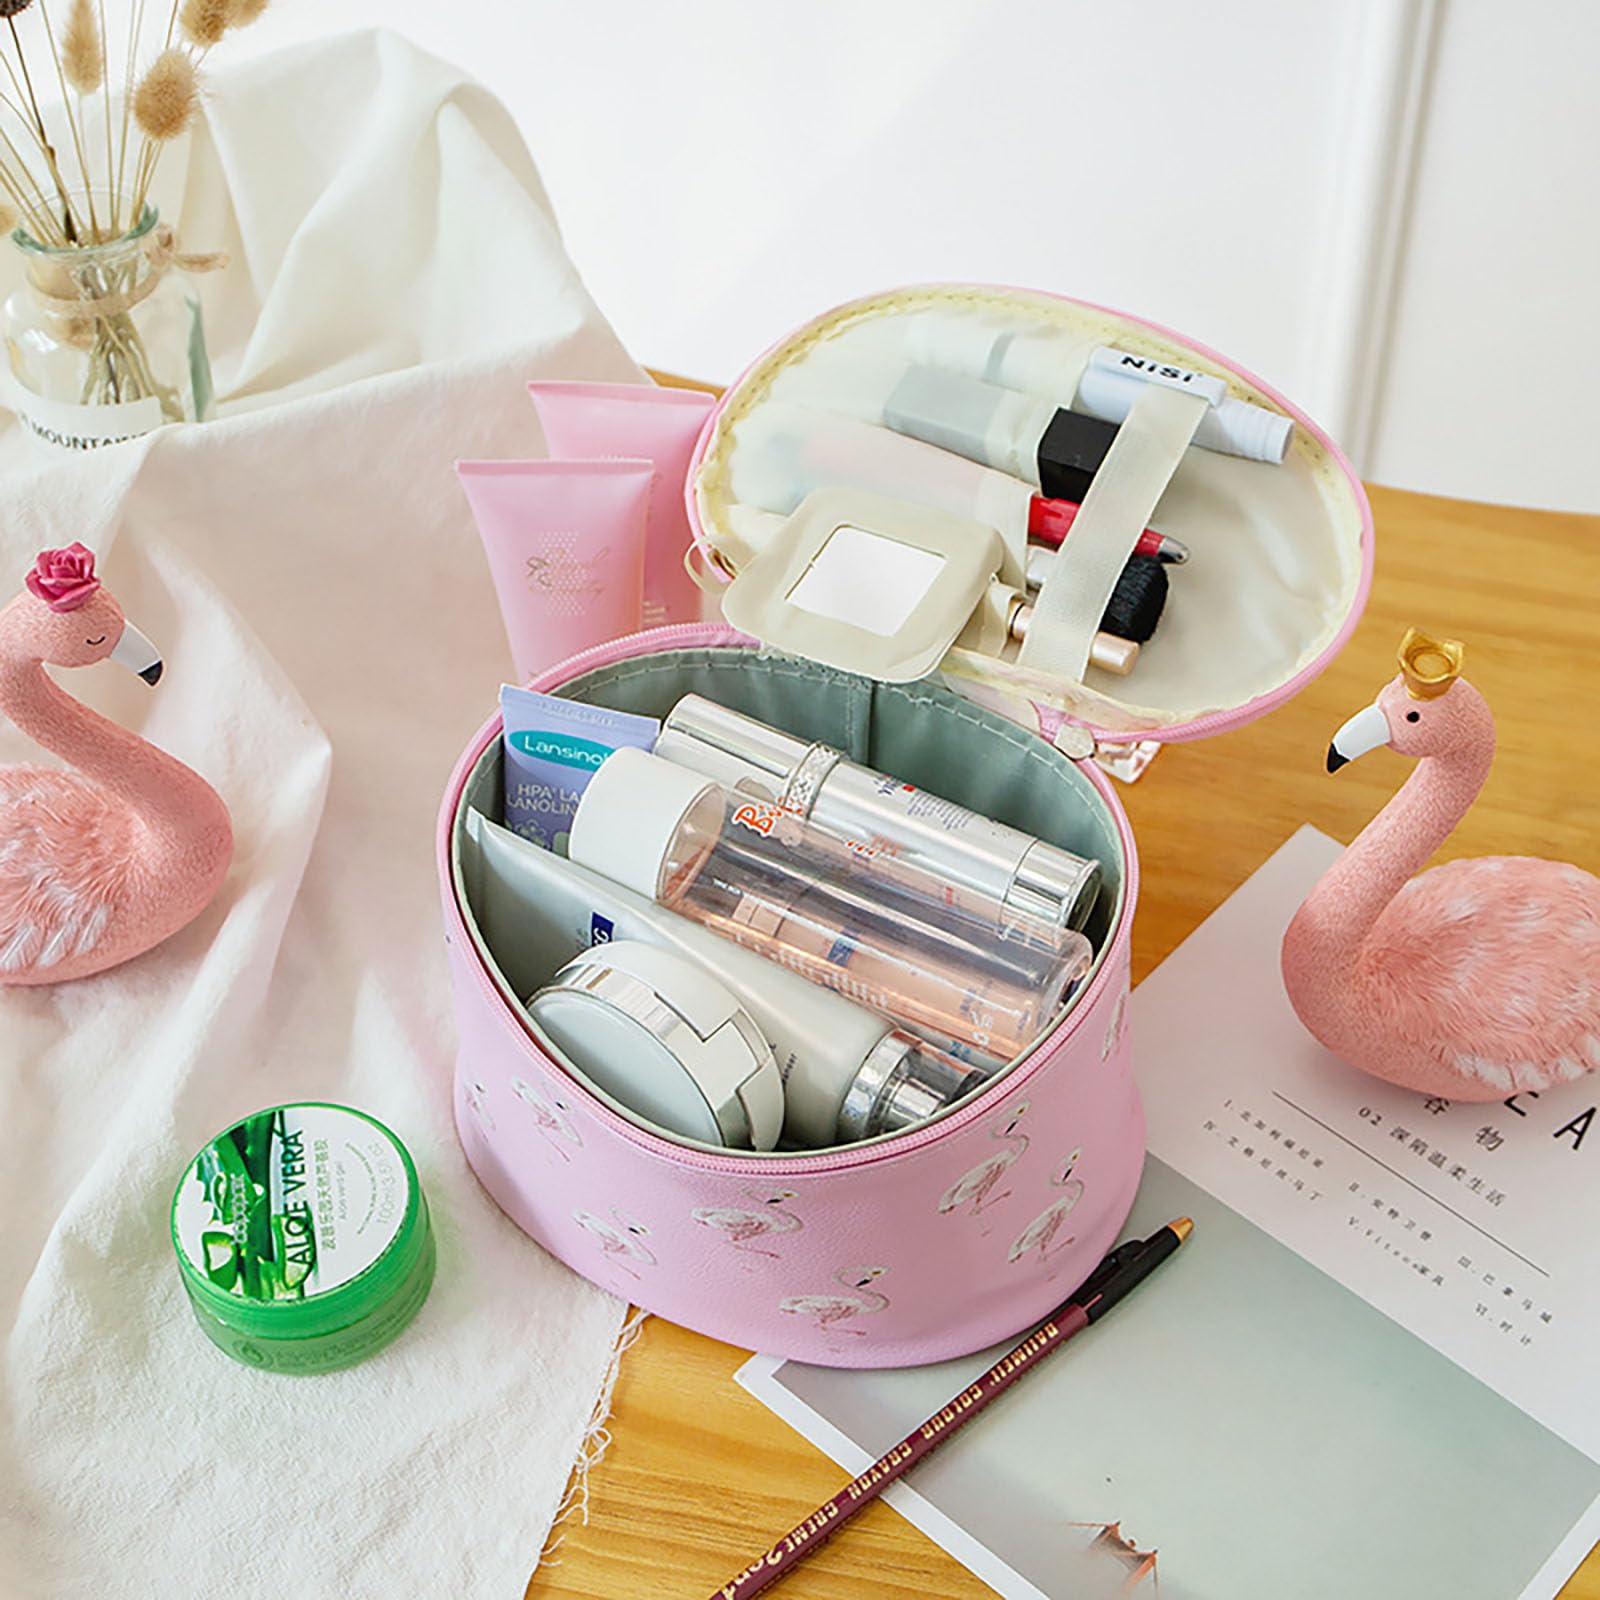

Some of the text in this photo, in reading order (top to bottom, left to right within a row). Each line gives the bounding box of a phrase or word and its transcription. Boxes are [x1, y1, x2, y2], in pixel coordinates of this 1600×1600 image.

[524, 735, 609, 766] Lansino
[560, 787, 584, 802] LA
[281, 1130, 313, 1266] ALOE VERA
[847, 1441, 913, 1500] CRAYON
[784, 1502, 838, 1553] CREME
